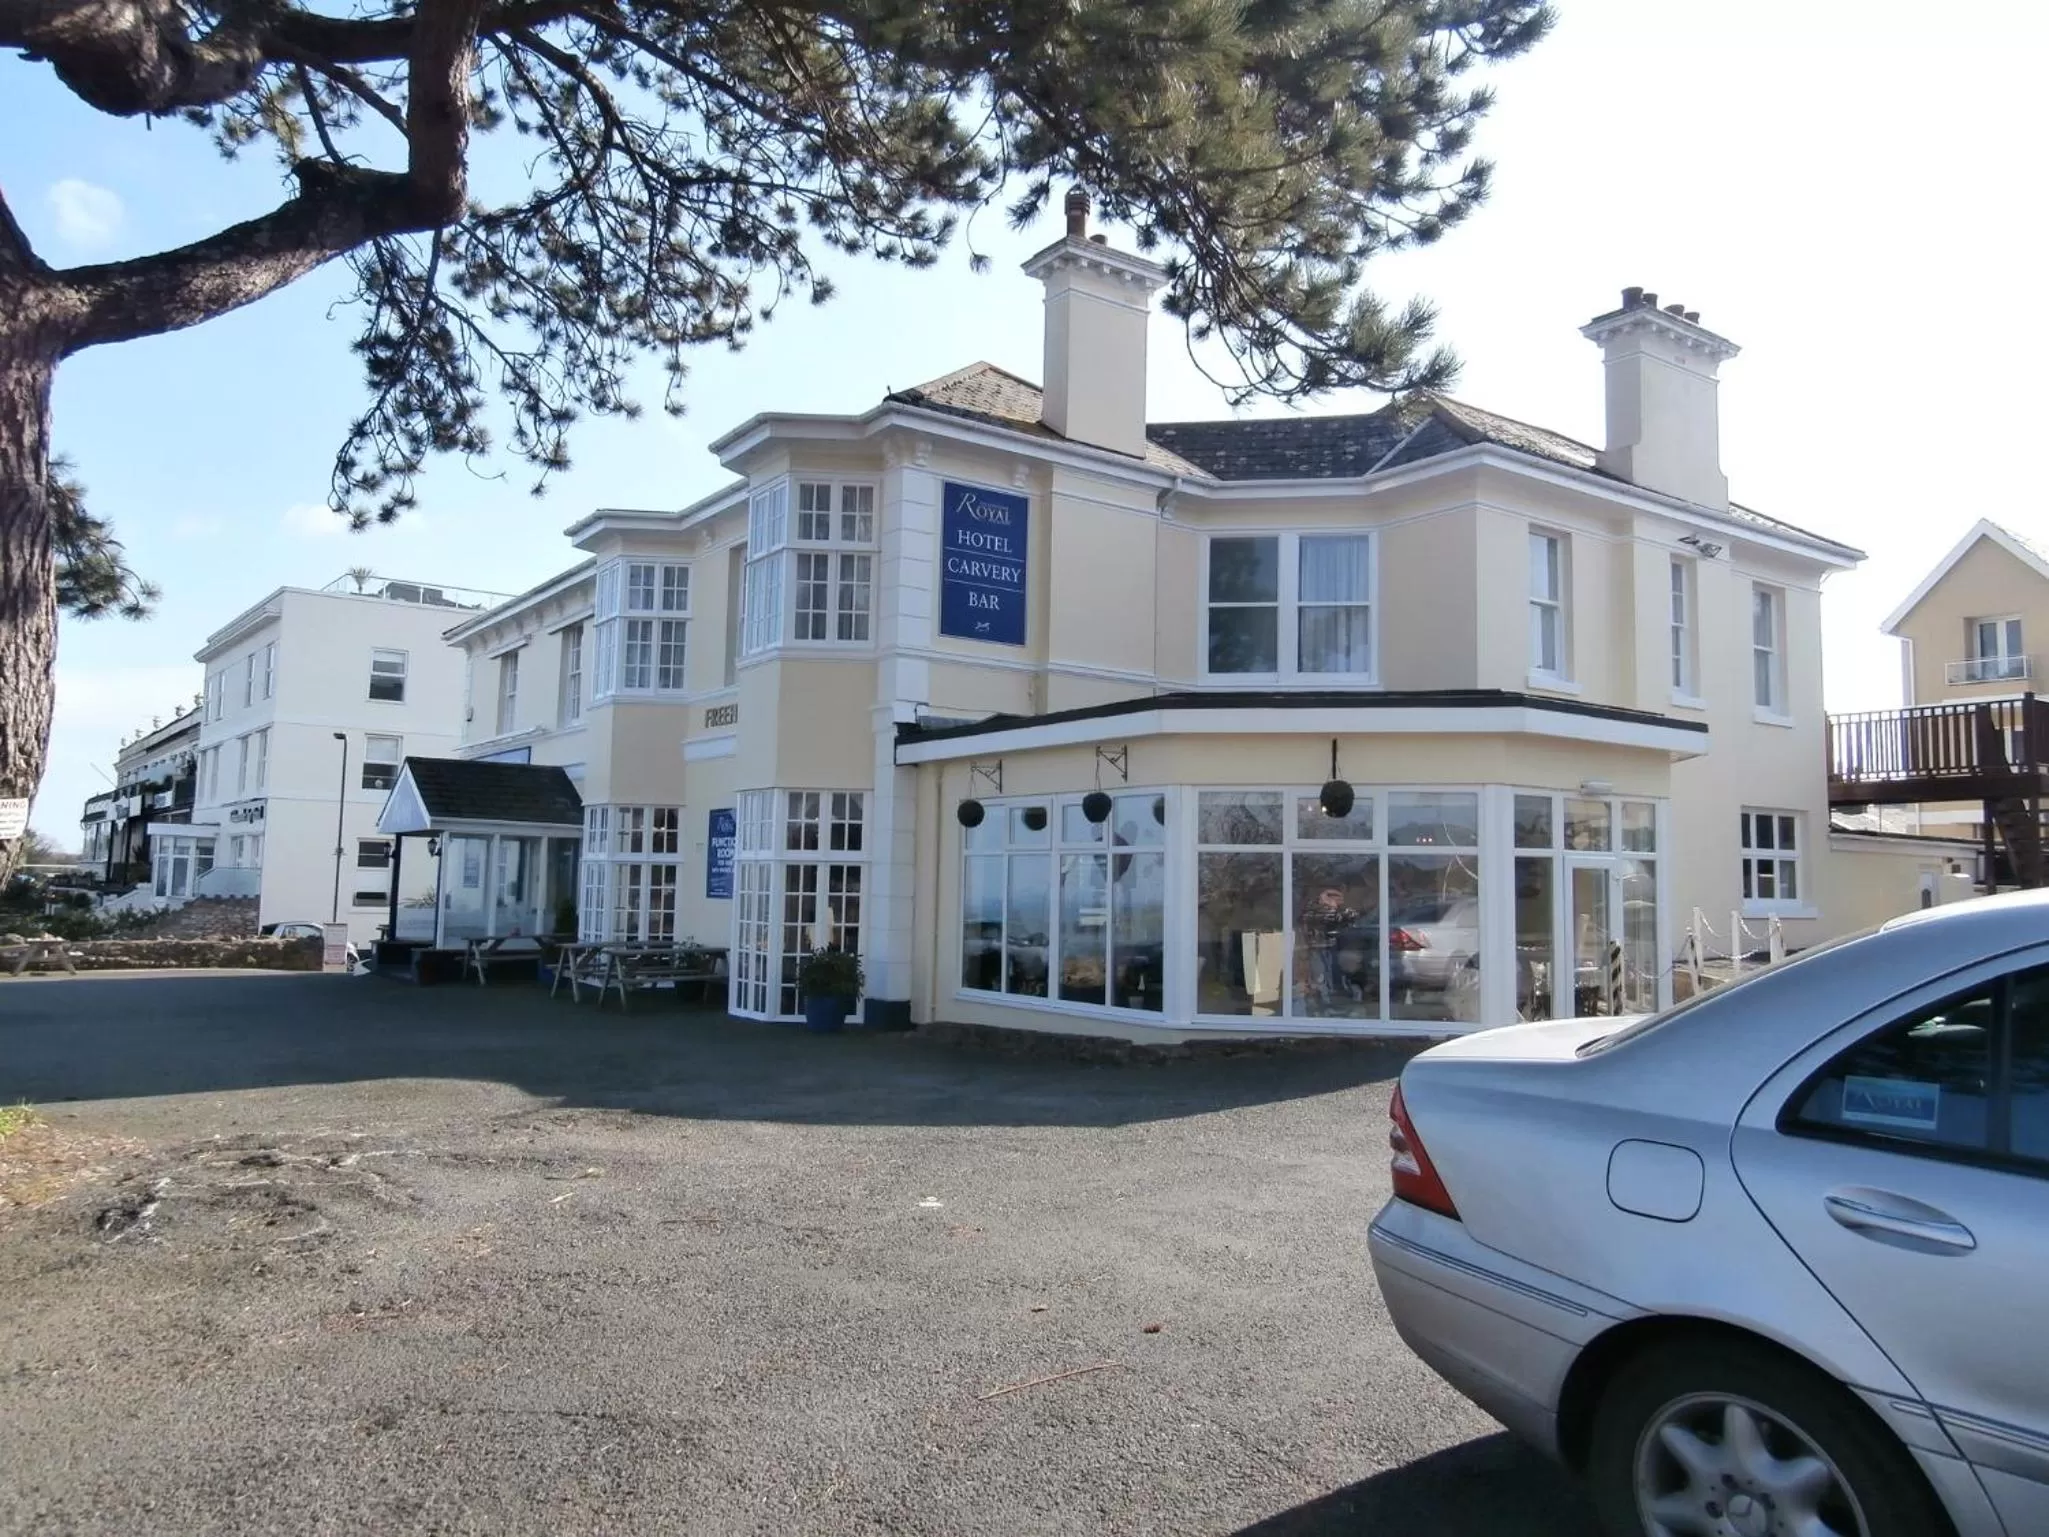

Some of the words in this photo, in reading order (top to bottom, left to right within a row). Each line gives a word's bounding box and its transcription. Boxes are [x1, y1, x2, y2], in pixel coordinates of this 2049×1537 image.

[956, 493, 1012, 525] ROYAL
[958, 530, 1012, 553] HOTEL
[947, 557, 1021, 583] CARVERY
[968, 592, 1000, 611] BAR
